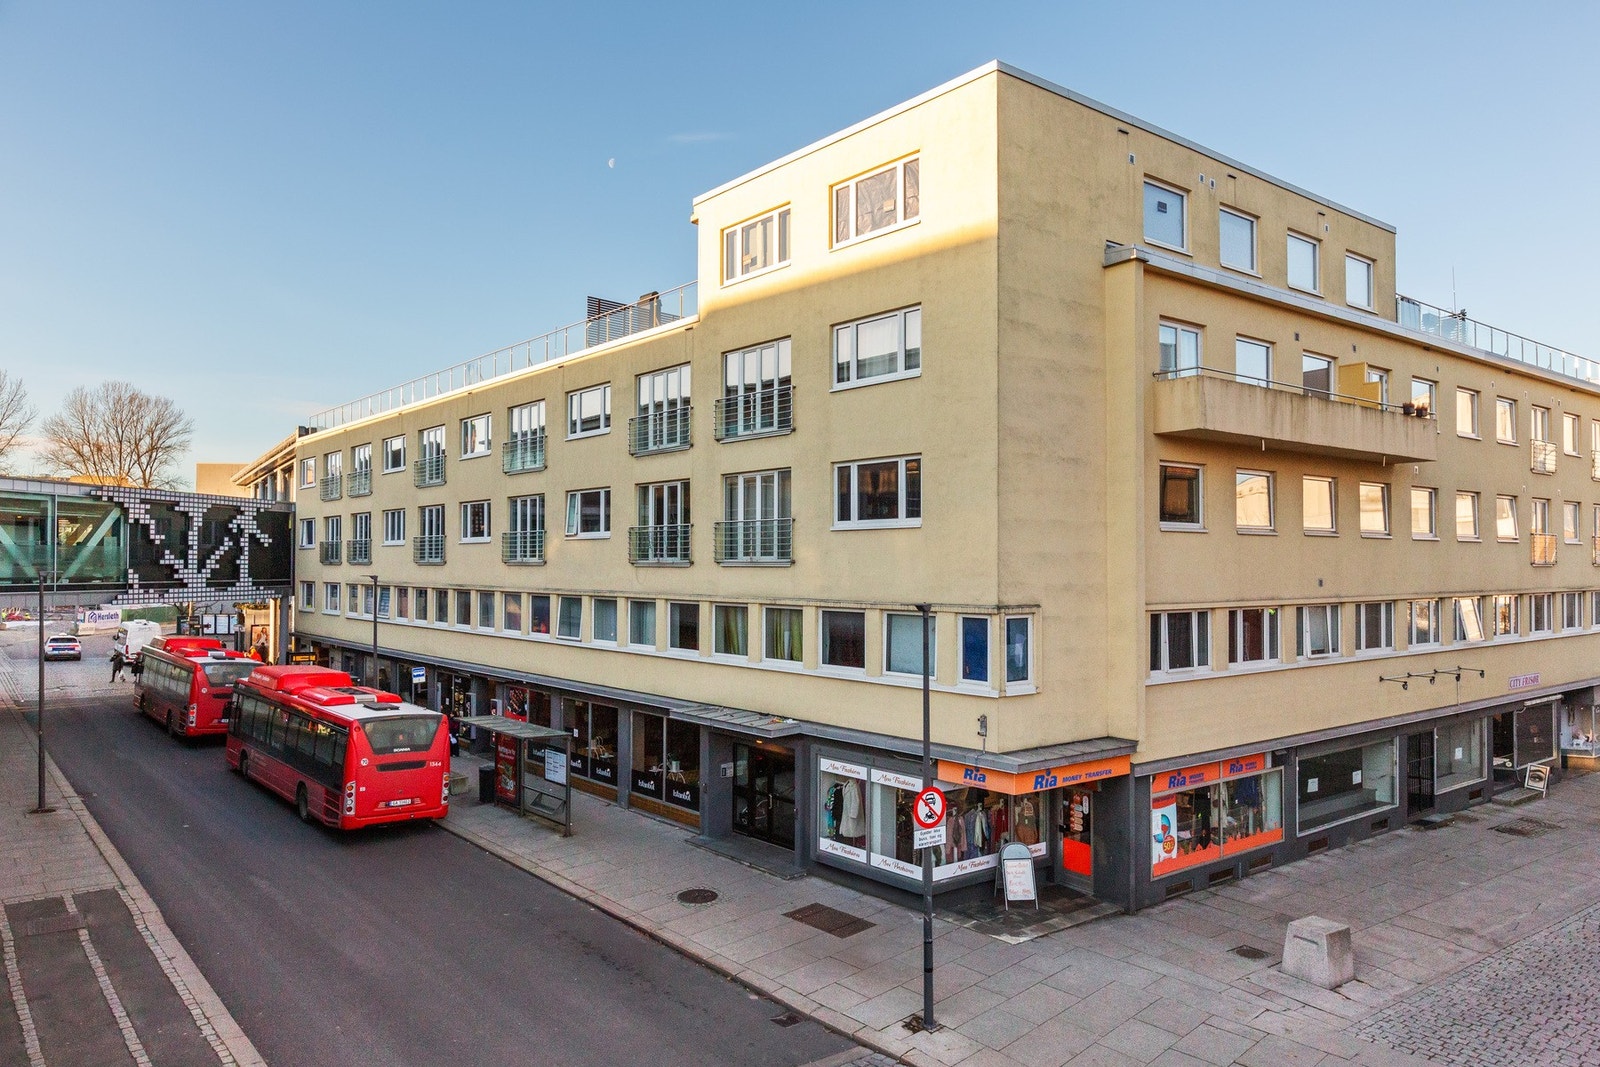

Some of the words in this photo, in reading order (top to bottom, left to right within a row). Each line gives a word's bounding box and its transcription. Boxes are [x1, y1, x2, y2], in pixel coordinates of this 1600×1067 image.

[963, 766, 987, 783] Ria
[1229, 759, 1244, 774] Ria
[638, 779, 655, 791] Istanbul
[1033, 768, 1058, 790] Ria
[1062, 774, 1082, 783] MONEY
[1085, 768, 1112, 779] TRANSFER
[1168, 770, 1187, 789] Ria
[672, 789, 691, 801] Istanbul
